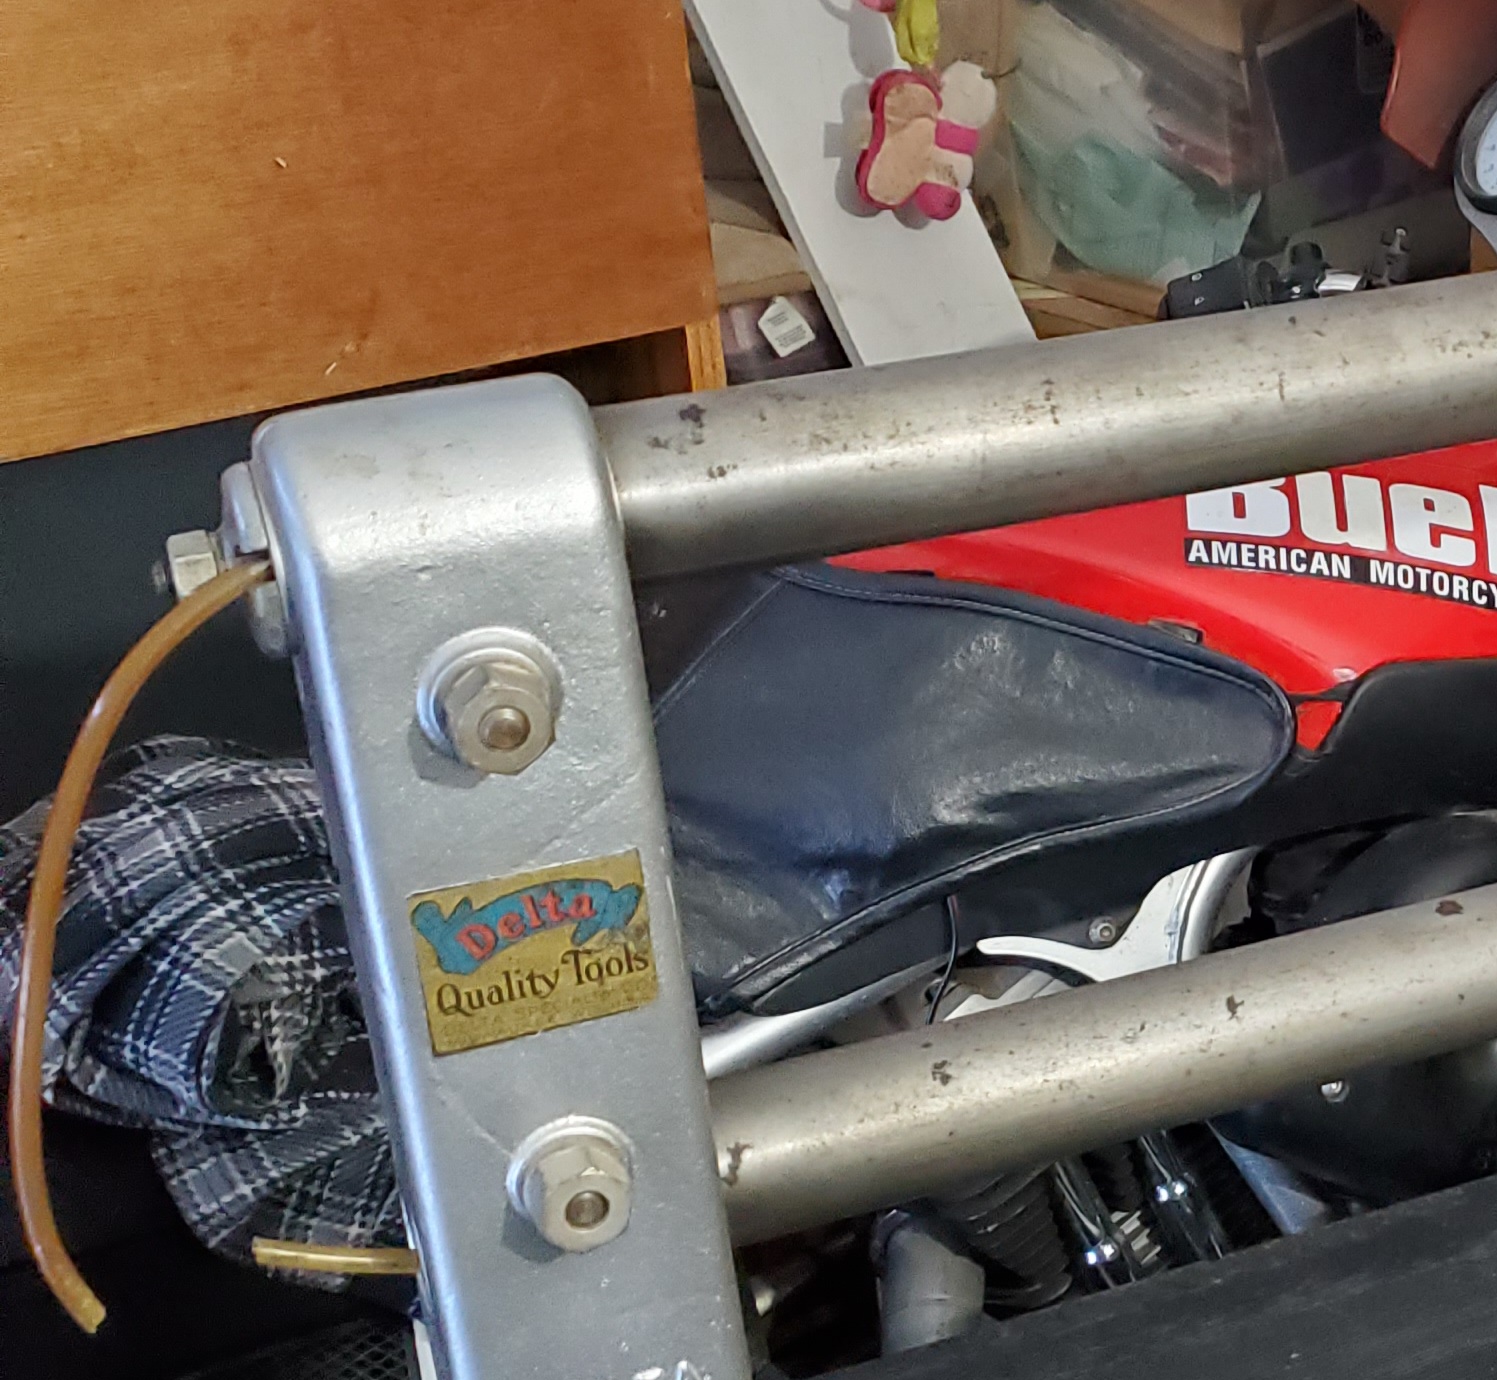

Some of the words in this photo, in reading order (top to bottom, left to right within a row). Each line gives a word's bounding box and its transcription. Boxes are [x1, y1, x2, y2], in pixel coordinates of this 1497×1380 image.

[1187, 539, 1351, 580] AMERICAN
[456, 890, 597, 962] Delta
[436, 966, 560, 1018] Quality
[560, 943, 650, 987] Tools
